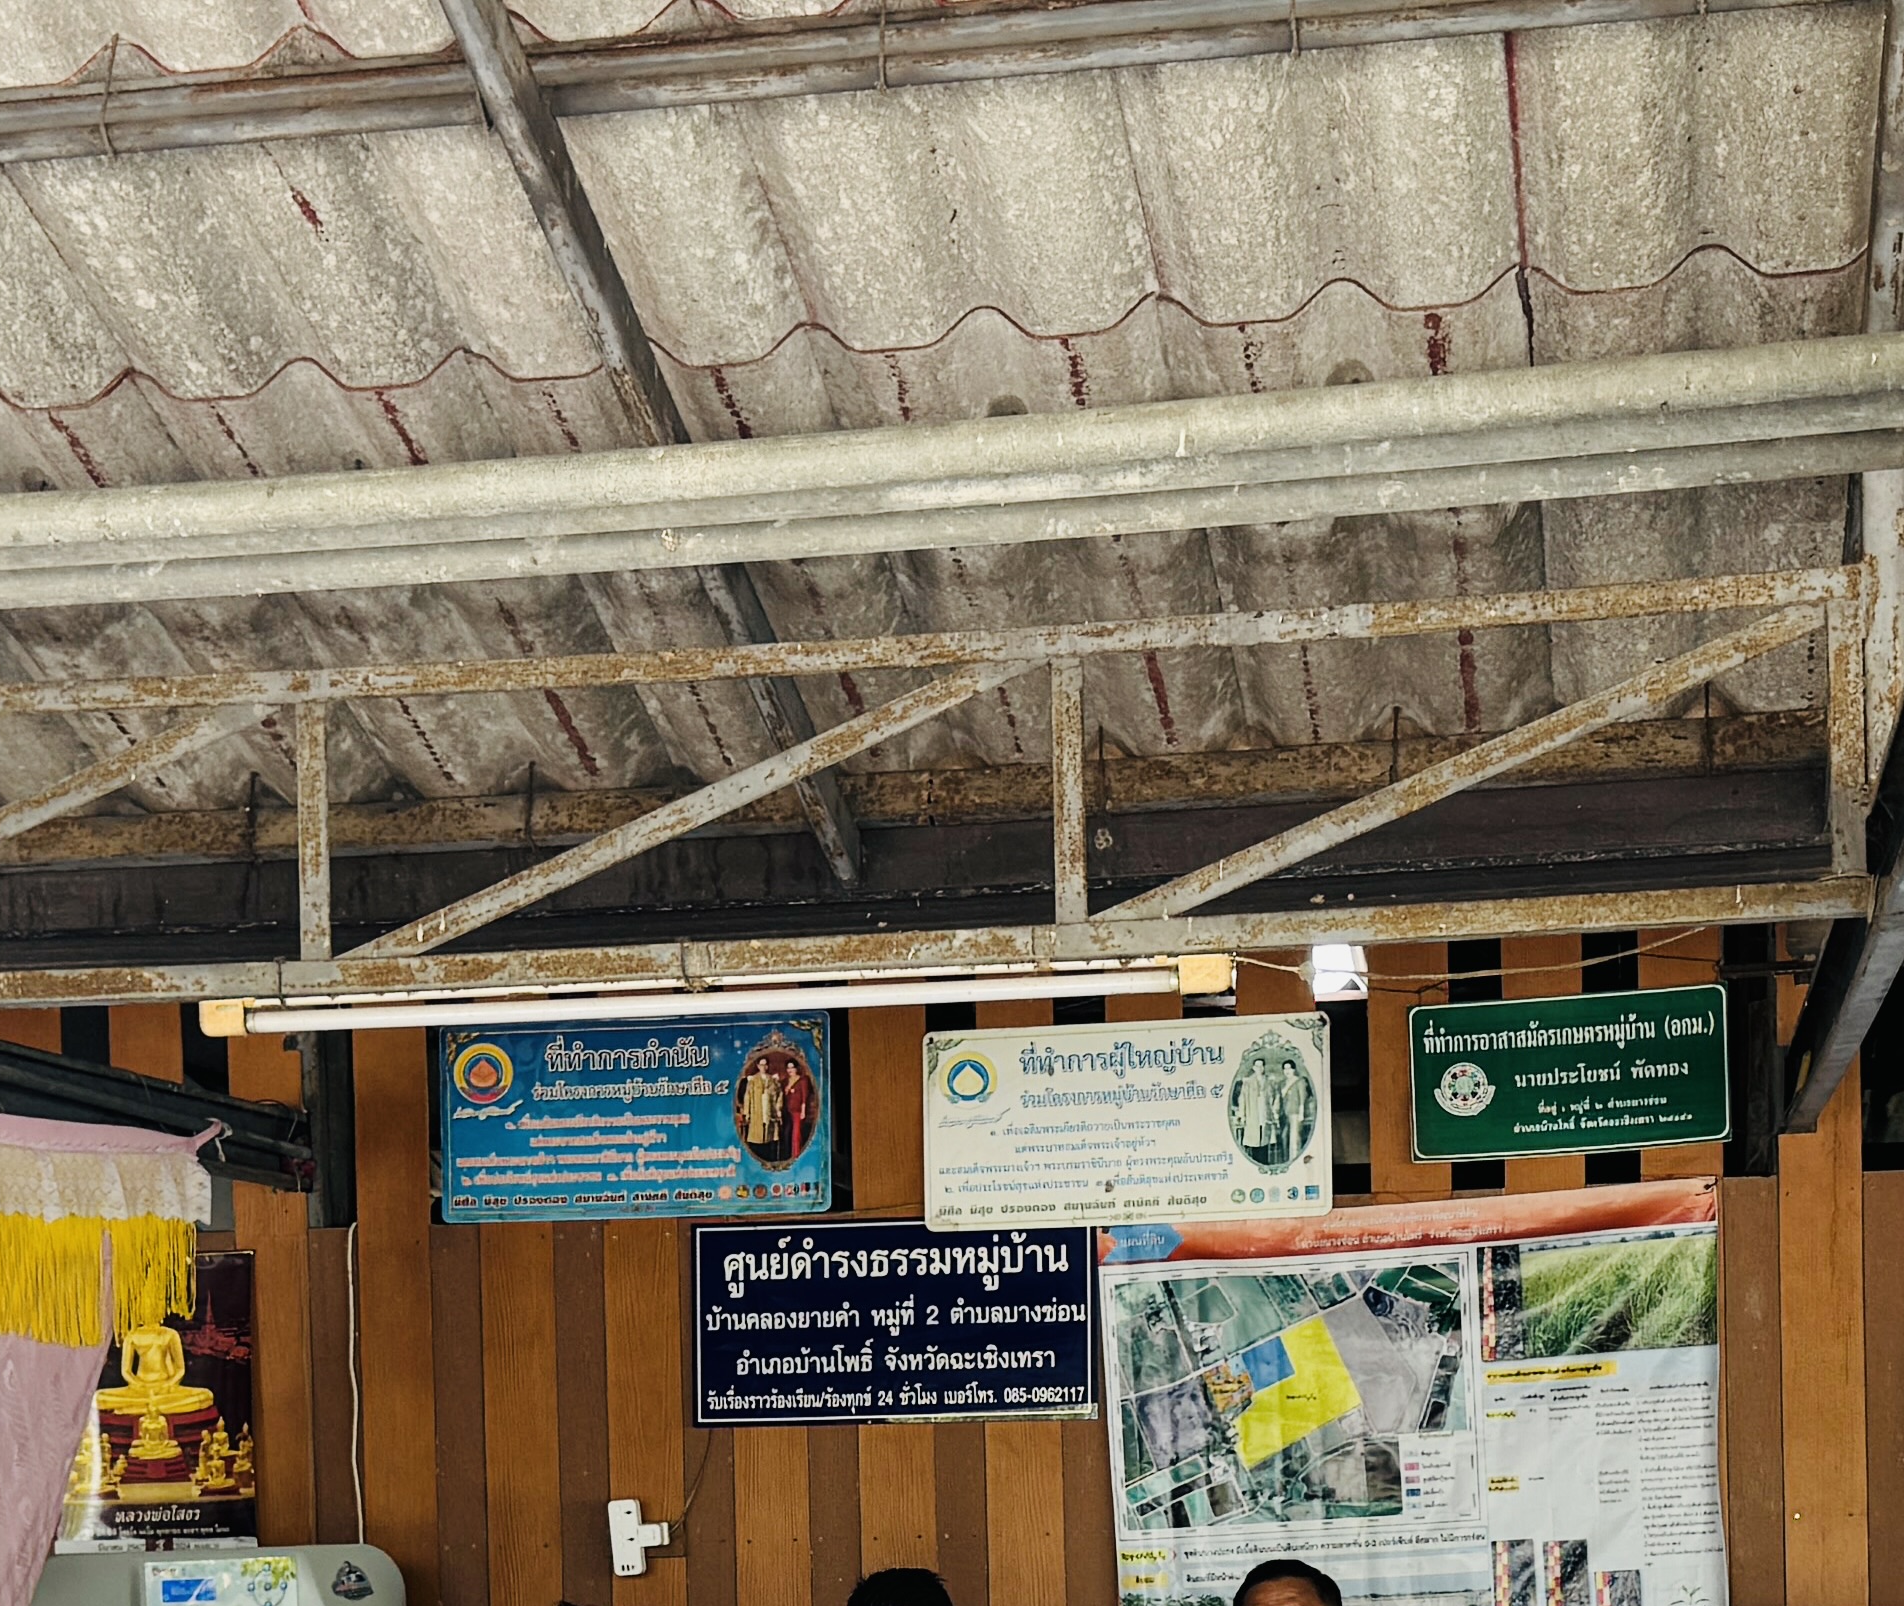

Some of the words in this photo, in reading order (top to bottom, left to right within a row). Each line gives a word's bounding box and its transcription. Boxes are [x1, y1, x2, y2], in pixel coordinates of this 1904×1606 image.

[1422, 1013, 1656, 1055] ที่ทำการอาสาสมัครเกษตรหมู่บ้าน
[1663, 1010, 1716, 1039] (อกม.)
[545, 1034, 711, 1072] ที่ทำการกำนัน
[1018, 1038, 1225, 1079] ที่ทำการผู้ใหญ่บ้าน
[1514, 1060, 1622, 1088] นายประโยชน์
[1020, 1080, 1207, 1111] ร่วมโครงการหมู่บ้านรักษาศีล
[1210, 1083, 1225, 1098] ๕
[1000, 1200, 1057, 1214] ปรองดอง
[723, 1231, 1070, 1299] ศูนย์ดำรงธรรมหมู่บ้าน
[706, 1301, 860, 1332] บ้านคลองยายคำ
[870, 1294, 916, 1337] หมู่ที่
[926, 1304, 939, 1326] 2
[949, 1297, 1086, 1326] ตำบลบางซ่อน
[736, 1338, 874, 1376] อำเภอบ้านโพธิ์
[883, 1341, 1056, 1374] จังหวัดฉะเชิงเทรา
[706, 1384, 873, 1416] รับเรื่องราวร้องเรียน/ร้องทุกข์
[877, 1390, 894, 1407] 24
[899, 1380, 938, 1406] ชั่วโมง
[944, 1381, 998, 1406] เบอร์โทร.
[1003, 1386, 1085, 1405] 085-0962117
